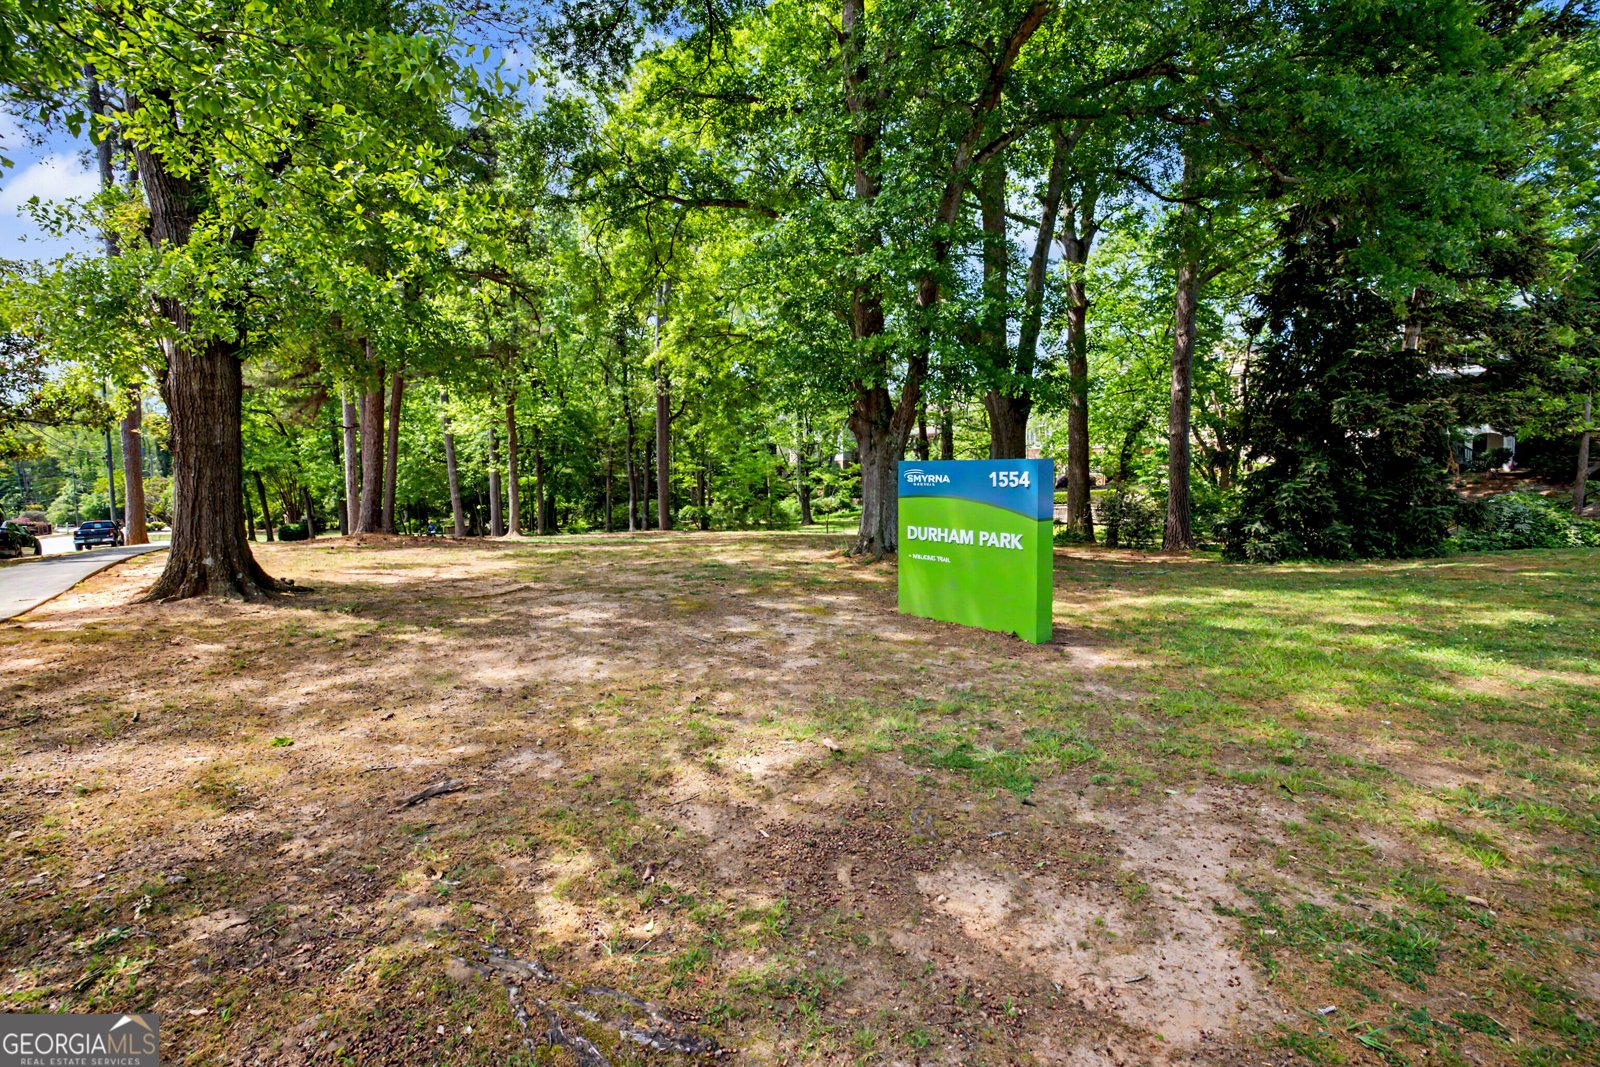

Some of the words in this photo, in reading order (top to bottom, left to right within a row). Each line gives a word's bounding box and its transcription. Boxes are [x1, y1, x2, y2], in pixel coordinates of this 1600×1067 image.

[906, 474, 950, 483] SMYRNA
[989, 471, 1030, 488] 1554
[907, 525, 974, 545] DURHAM
[979, 531, 1023, 550] PARK
[937, 555, 951, 563] TRAIL
